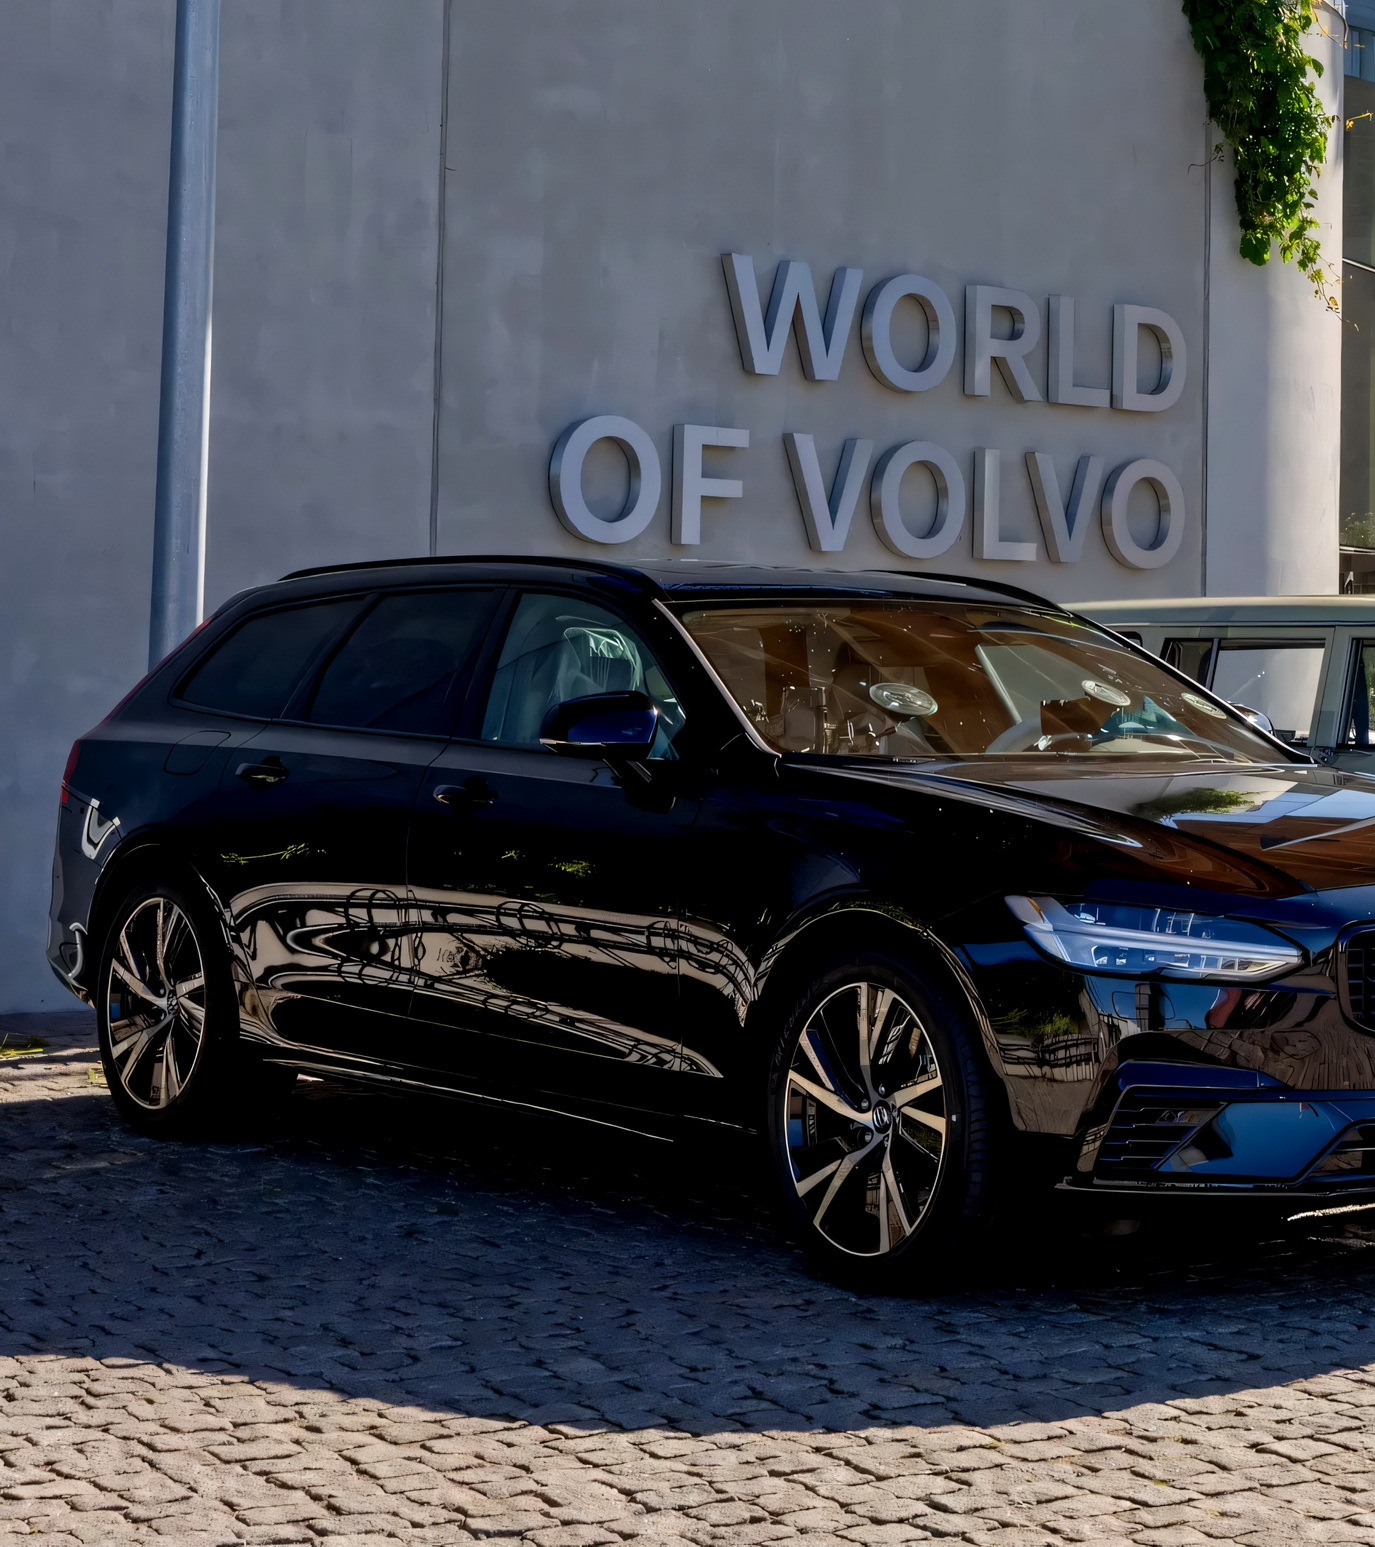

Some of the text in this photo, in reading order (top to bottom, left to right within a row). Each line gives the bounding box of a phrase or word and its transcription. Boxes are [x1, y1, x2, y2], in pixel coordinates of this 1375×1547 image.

[720, 252, 1187, 412] WORLD
[548, 415, 1186, 570] OF VOLVO
